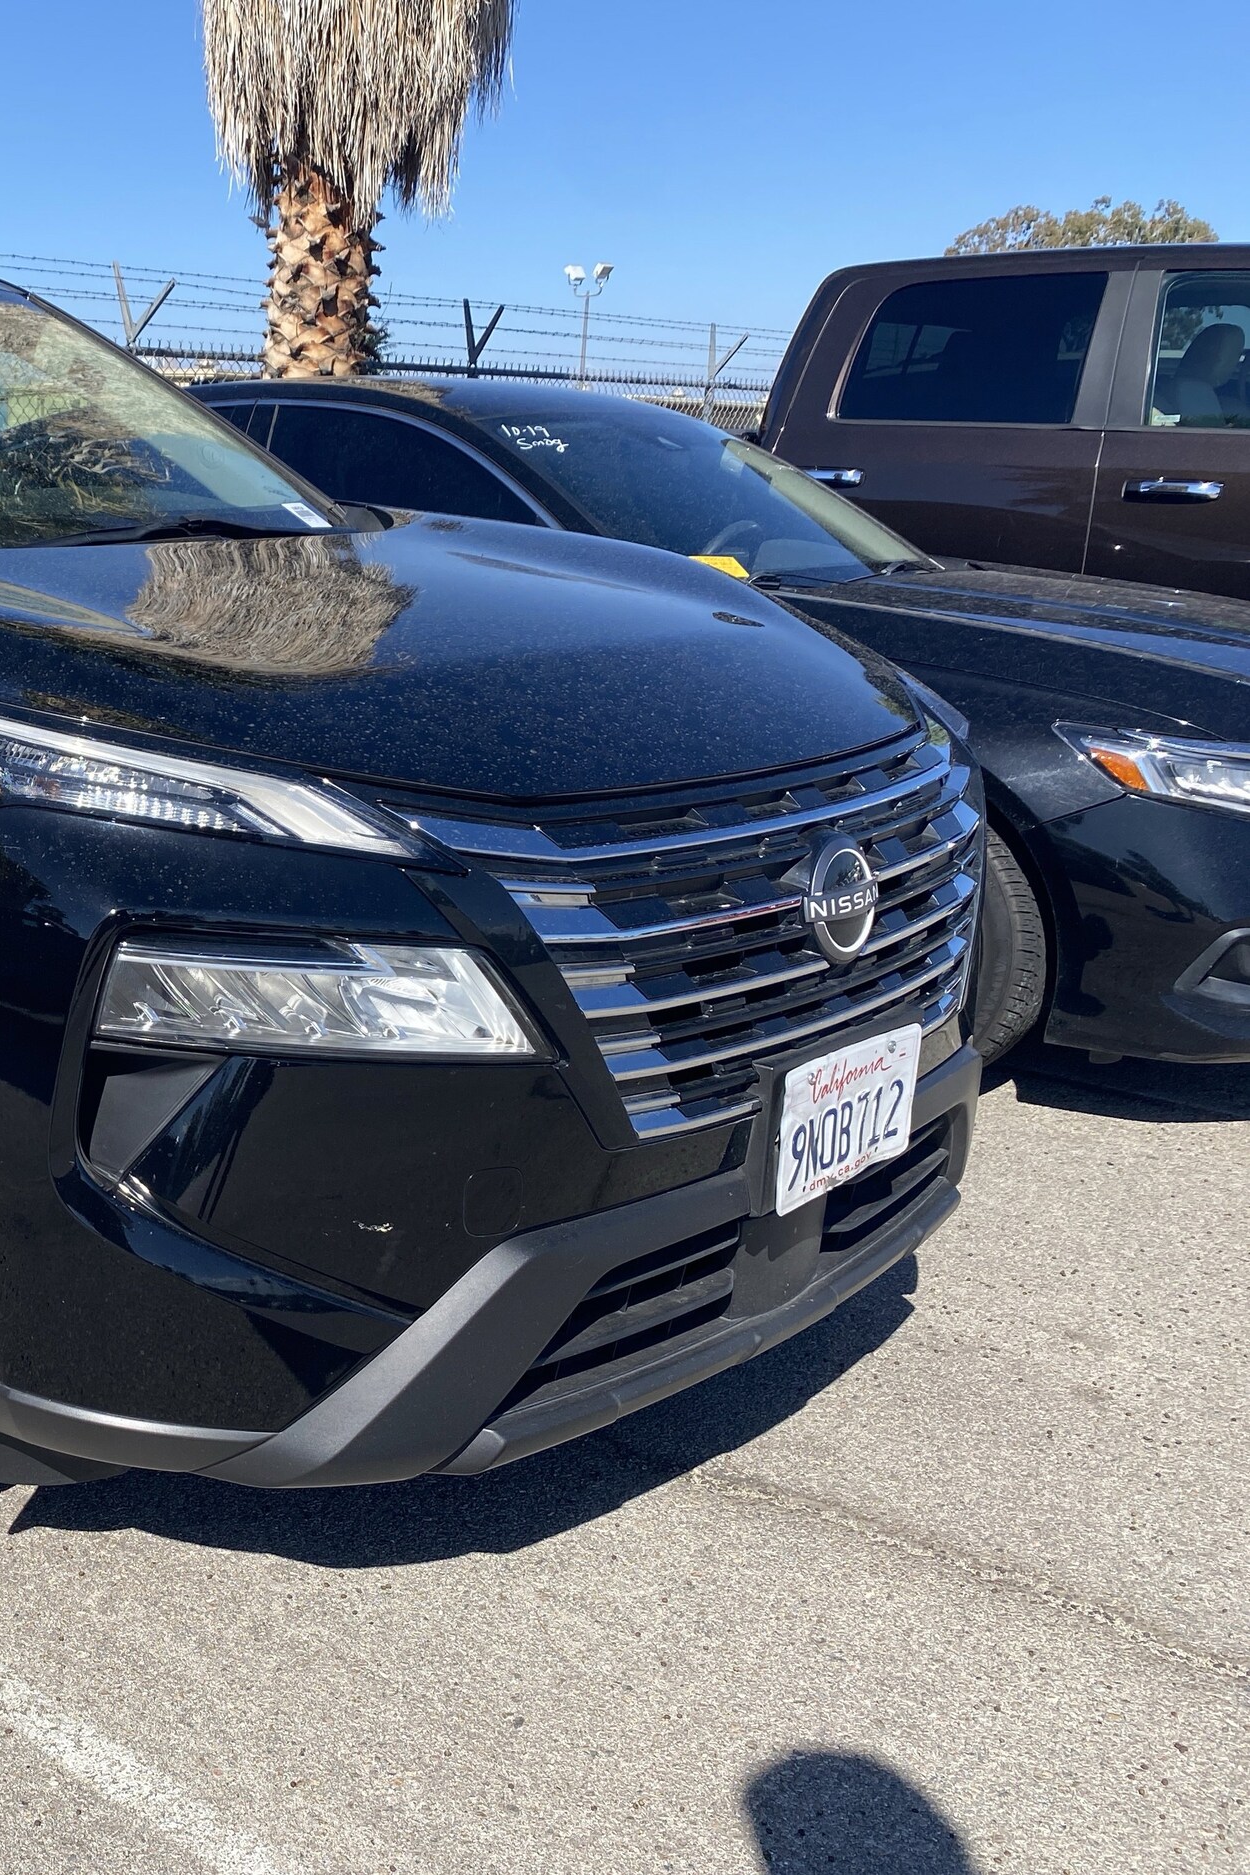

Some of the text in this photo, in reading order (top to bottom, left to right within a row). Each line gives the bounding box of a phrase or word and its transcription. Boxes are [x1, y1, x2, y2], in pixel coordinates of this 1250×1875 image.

[501, 424, 550, 437] 10-19
[810, 882, 879, 919] NISSAN
[809, 1055, 892, 1104] California
